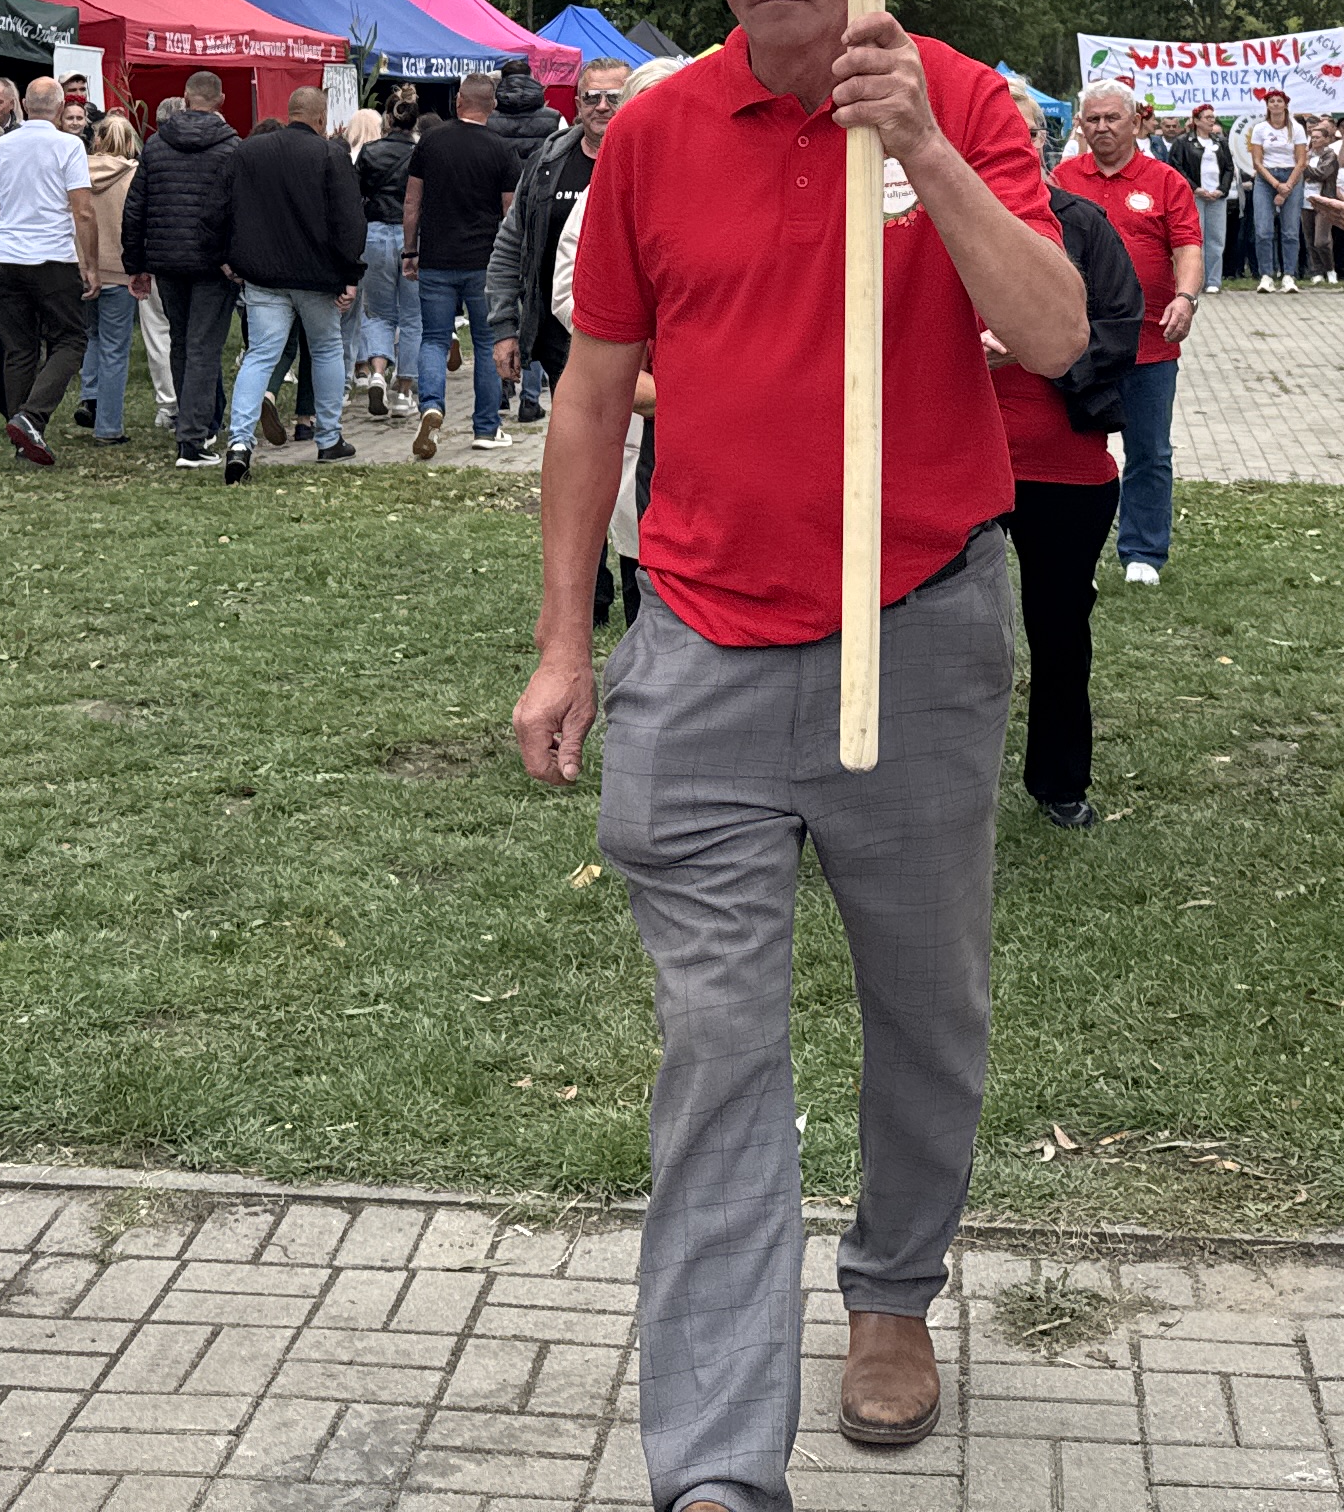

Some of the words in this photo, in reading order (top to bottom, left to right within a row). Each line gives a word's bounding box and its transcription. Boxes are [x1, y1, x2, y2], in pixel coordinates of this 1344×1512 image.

[165, 32, 192, 54] KGW
[402, 56, 427, 77] KGW
[1145, 71, 1194, 87] JEDNA
[1171, 88, 1230, 104] WIELKA
